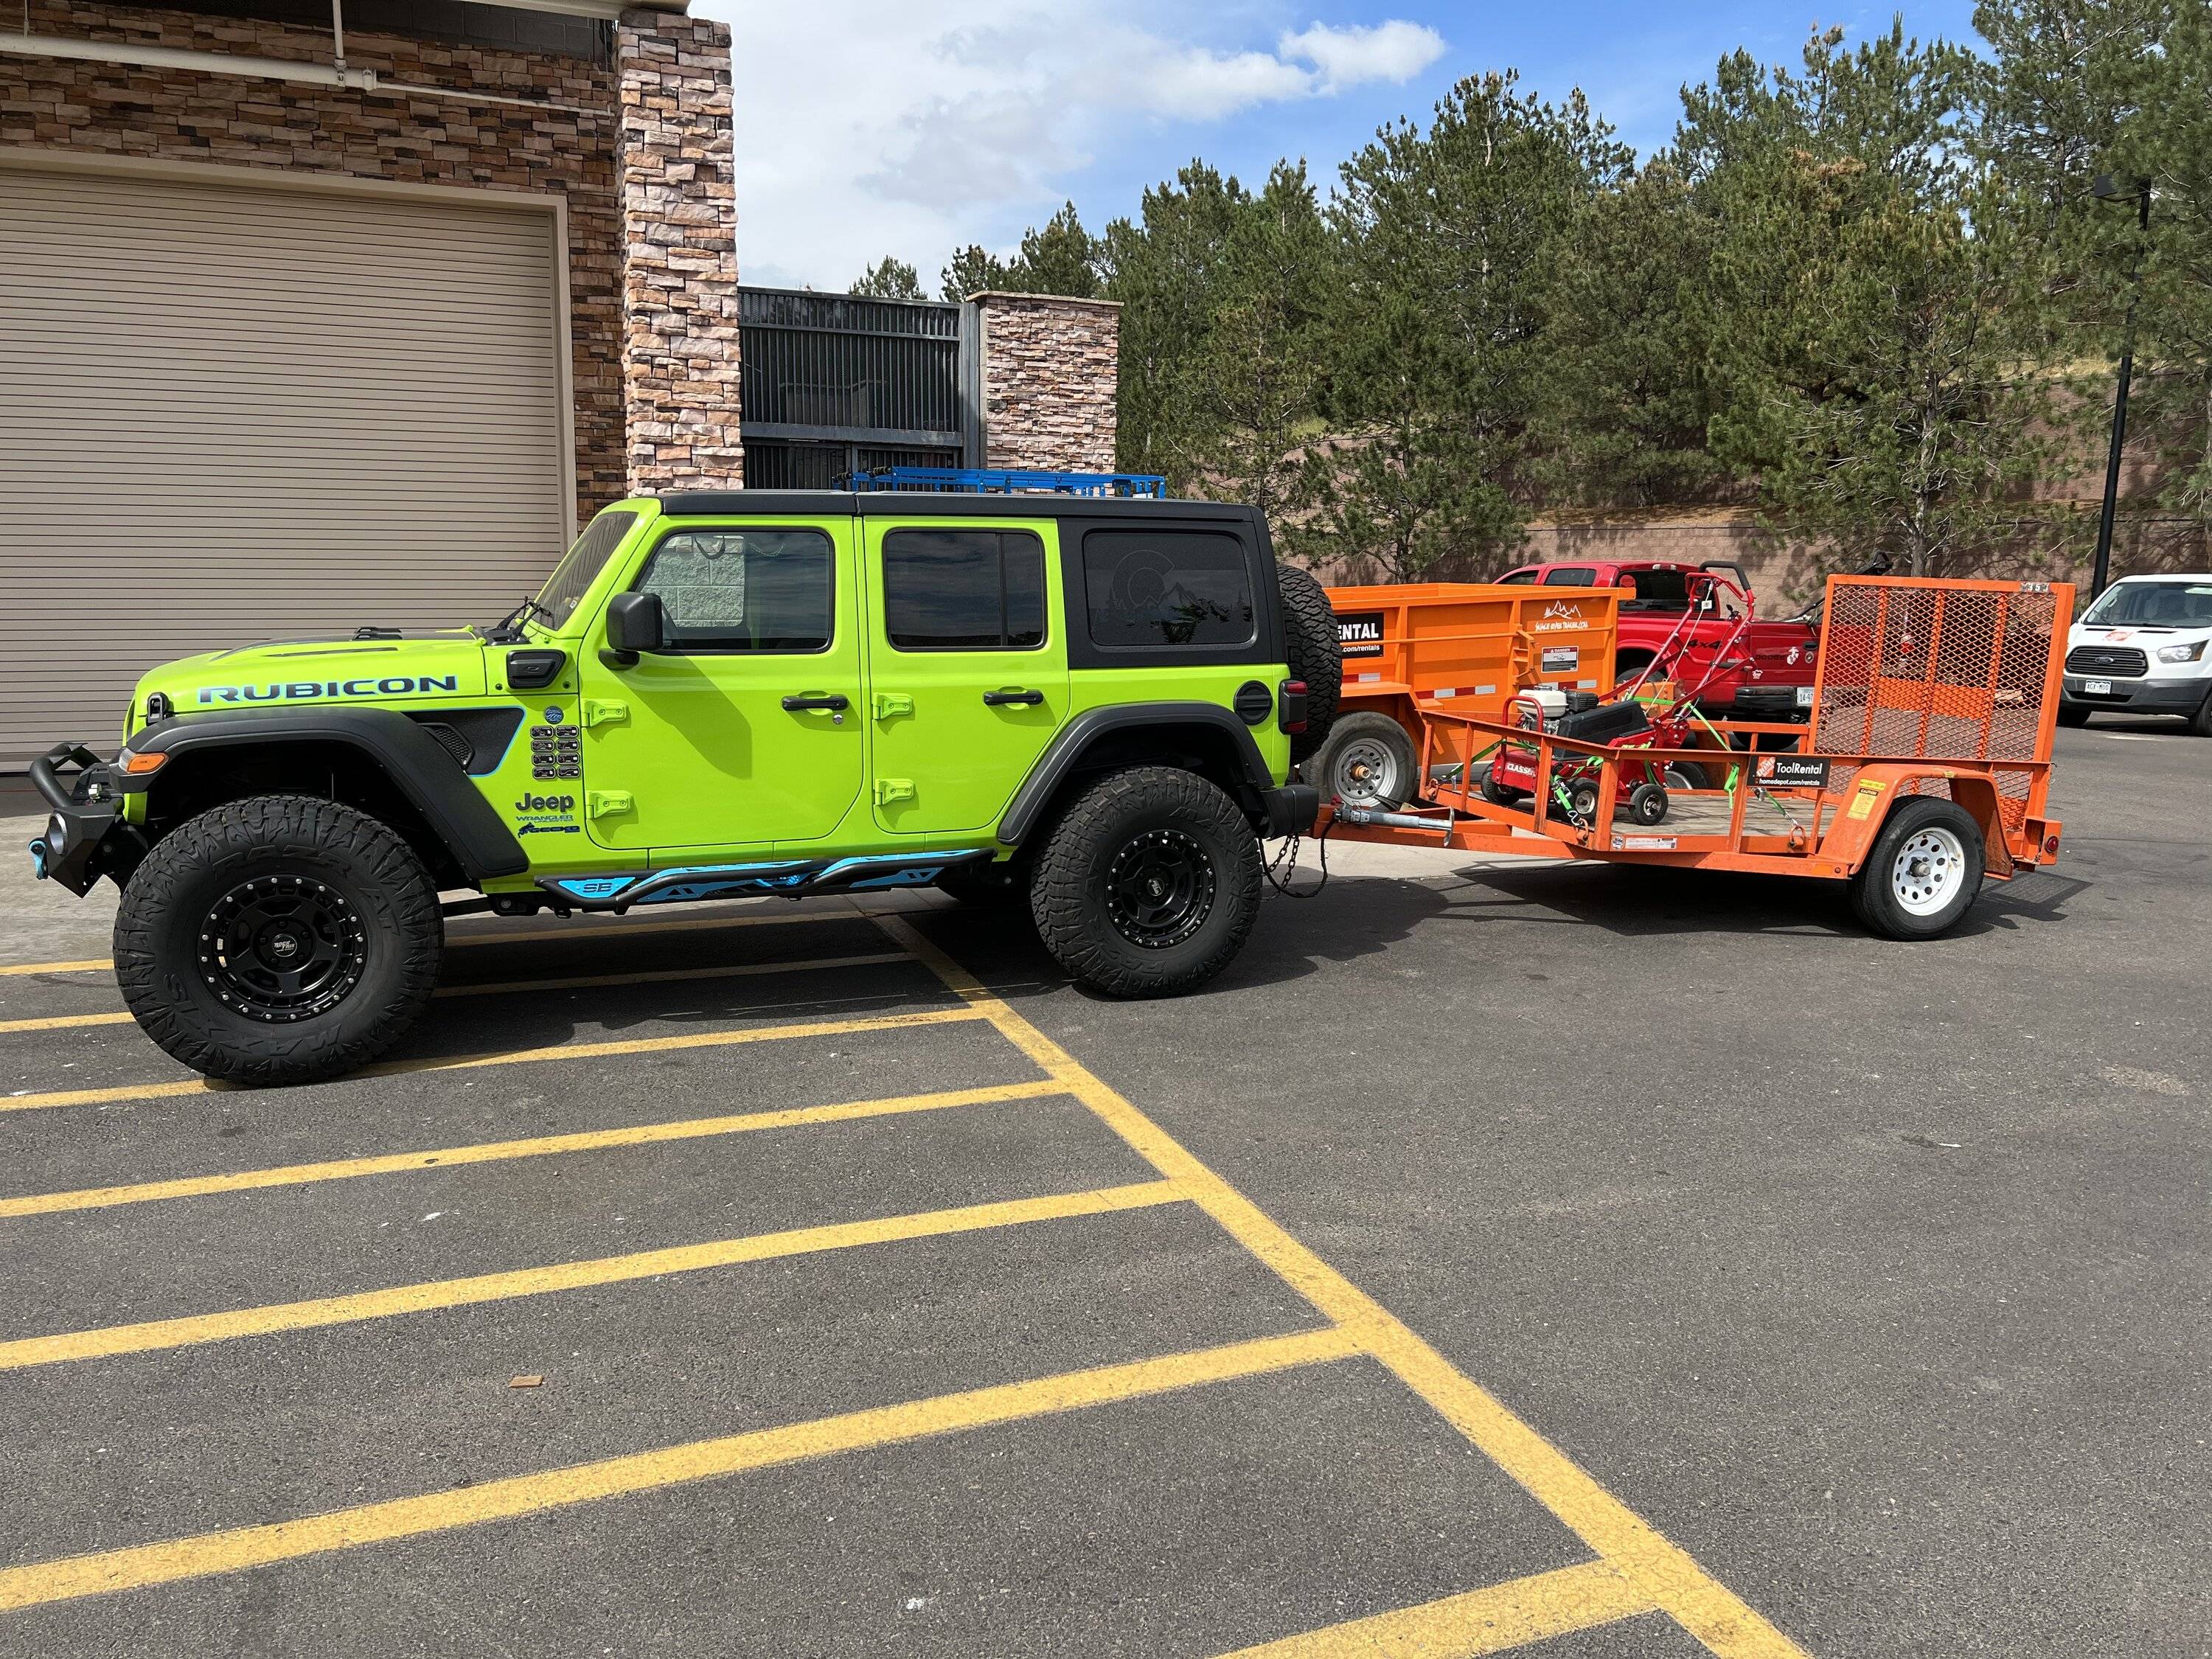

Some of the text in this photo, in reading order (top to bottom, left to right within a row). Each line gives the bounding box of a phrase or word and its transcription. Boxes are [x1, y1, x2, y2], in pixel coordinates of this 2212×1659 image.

[1338, 623, 1379, 640] ENTAL
[200, 675, 458, 703] RUBICON
[1776, 762, 1823, 774] ToolRental
[1759, 778, 1820, 786] homedepot.com/rentals
[515, 792, 574, 812] Jeep
